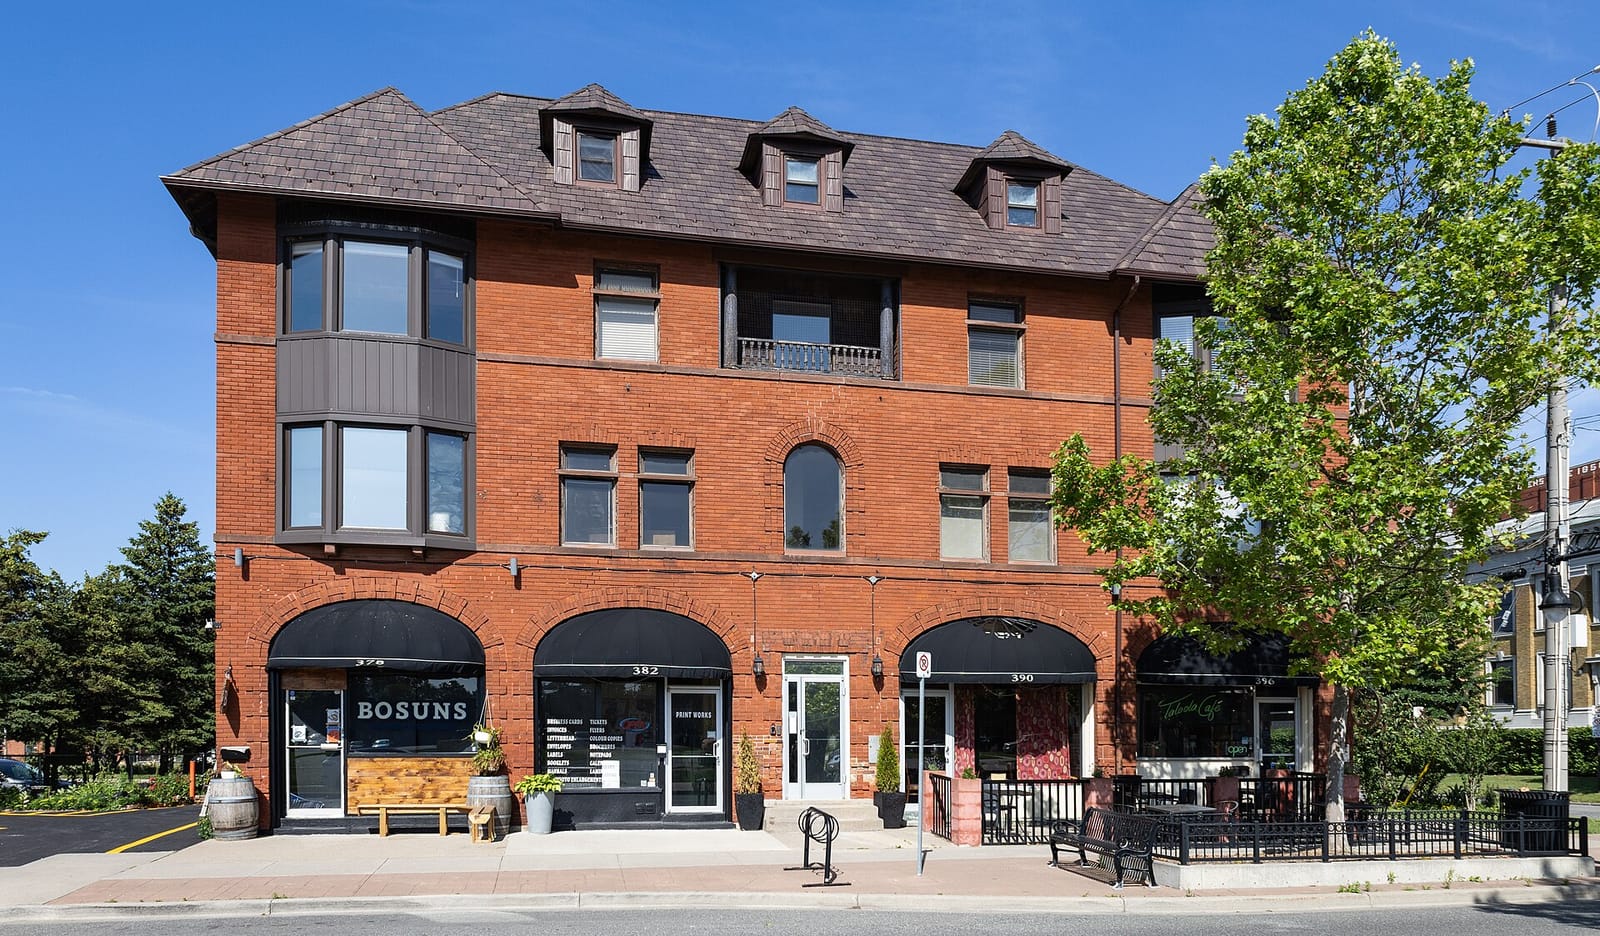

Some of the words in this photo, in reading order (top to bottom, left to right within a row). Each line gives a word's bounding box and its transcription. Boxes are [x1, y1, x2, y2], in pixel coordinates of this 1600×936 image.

[632, 666, 659, 675] 382
[1011, 674, 1034, 682] 390
[1255, 677, 1275, 685] 396
[357, 701, 467, 720] BOSUNS
[693, 711, 712, 719] WORKS
[1228, 745, 1247, 757] open
